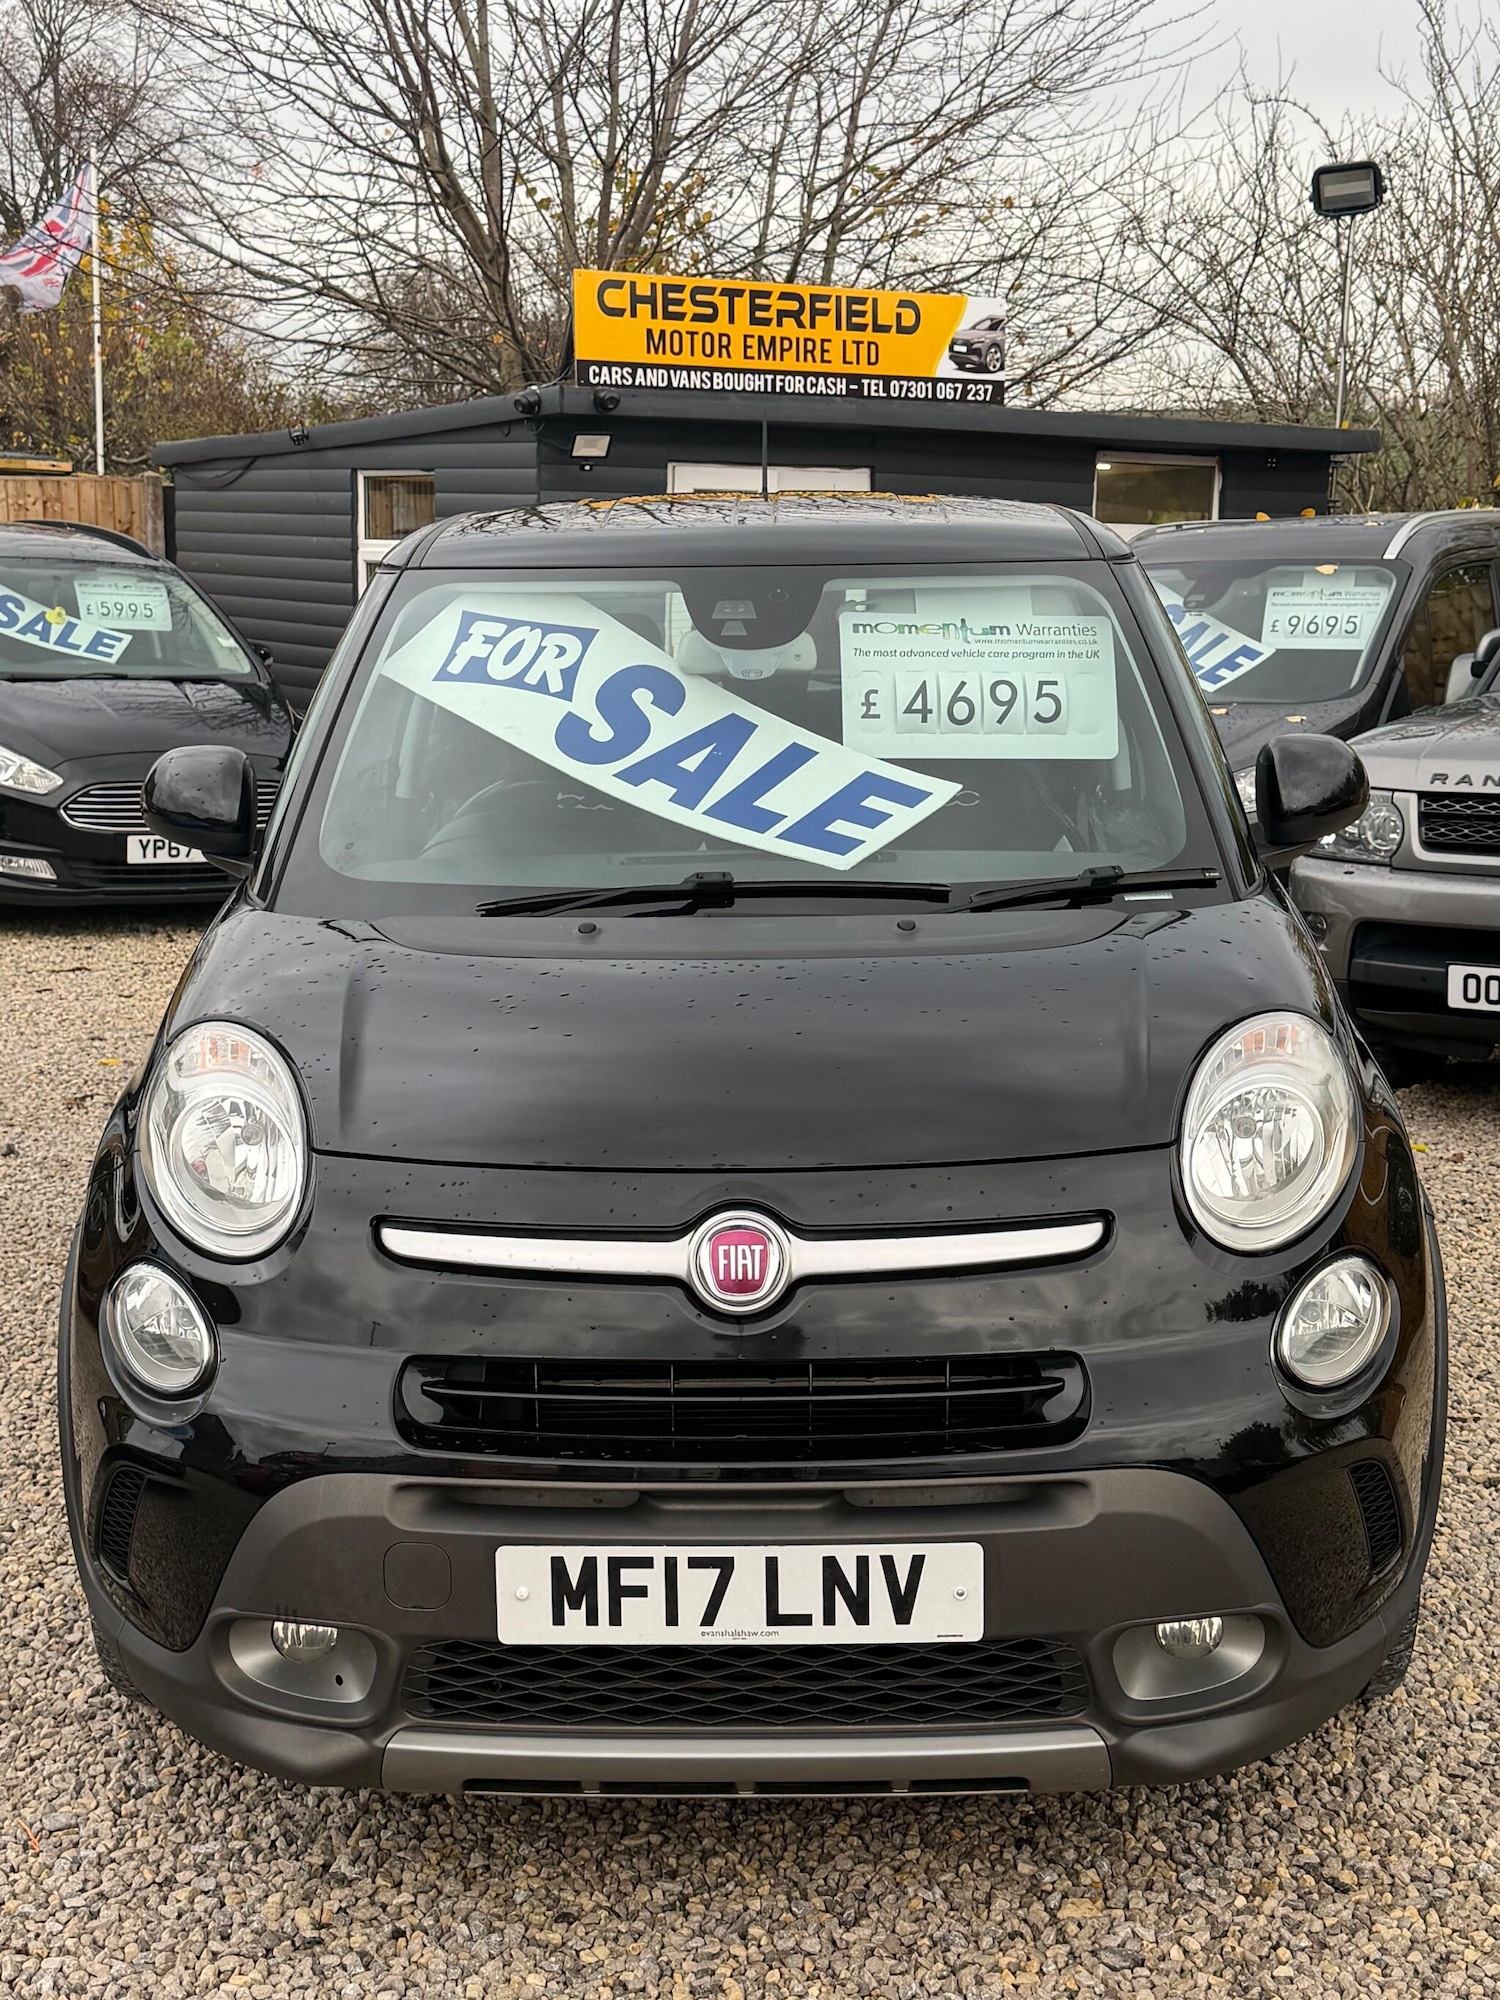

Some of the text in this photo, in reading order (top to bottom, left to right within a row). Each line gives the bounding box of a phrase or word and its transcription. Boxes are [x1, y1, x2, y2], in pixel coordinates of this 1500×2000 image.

[597, 278, 921, 335] CHESTERFIELD
[646, 327, 880, 366] MOTOR EMPIRE LTD
[588, 364, 633, 386] CARS
[634, 367, 669, 388] AND
[669, 369, 712, 390] VANS
[712, 371, 775, 393] BOUGHT
[775, 375, 804, 394] FOR
[806, 376, 847, 396] CASH
[861, 379, 887, 397] TEL
[889, 380, 932, 399] 07301
[936, 382, 962, 400] 067
[966, 384, 994, 401] 237
[0, 594, 124, 659] SALE
[100, 601, 154, 619] 5995
[1270, 615, 1359, 635] £ 9695
[852, 617, 1098, 644] momentum Warranties
[445, 620, 586, 695] FOR
[853, 647, 1101, 661] The most advanced vehicle care program in the UK
[860, 679, 1063, 727] £ 4695
[554, 664, 934, 857] SALE
[718, 1244, 764, 1281] FIAT
[550, 1554, 926, 1628] MF17 LNV
[701, 1629, 779, 1638] evanshalshaw.com
